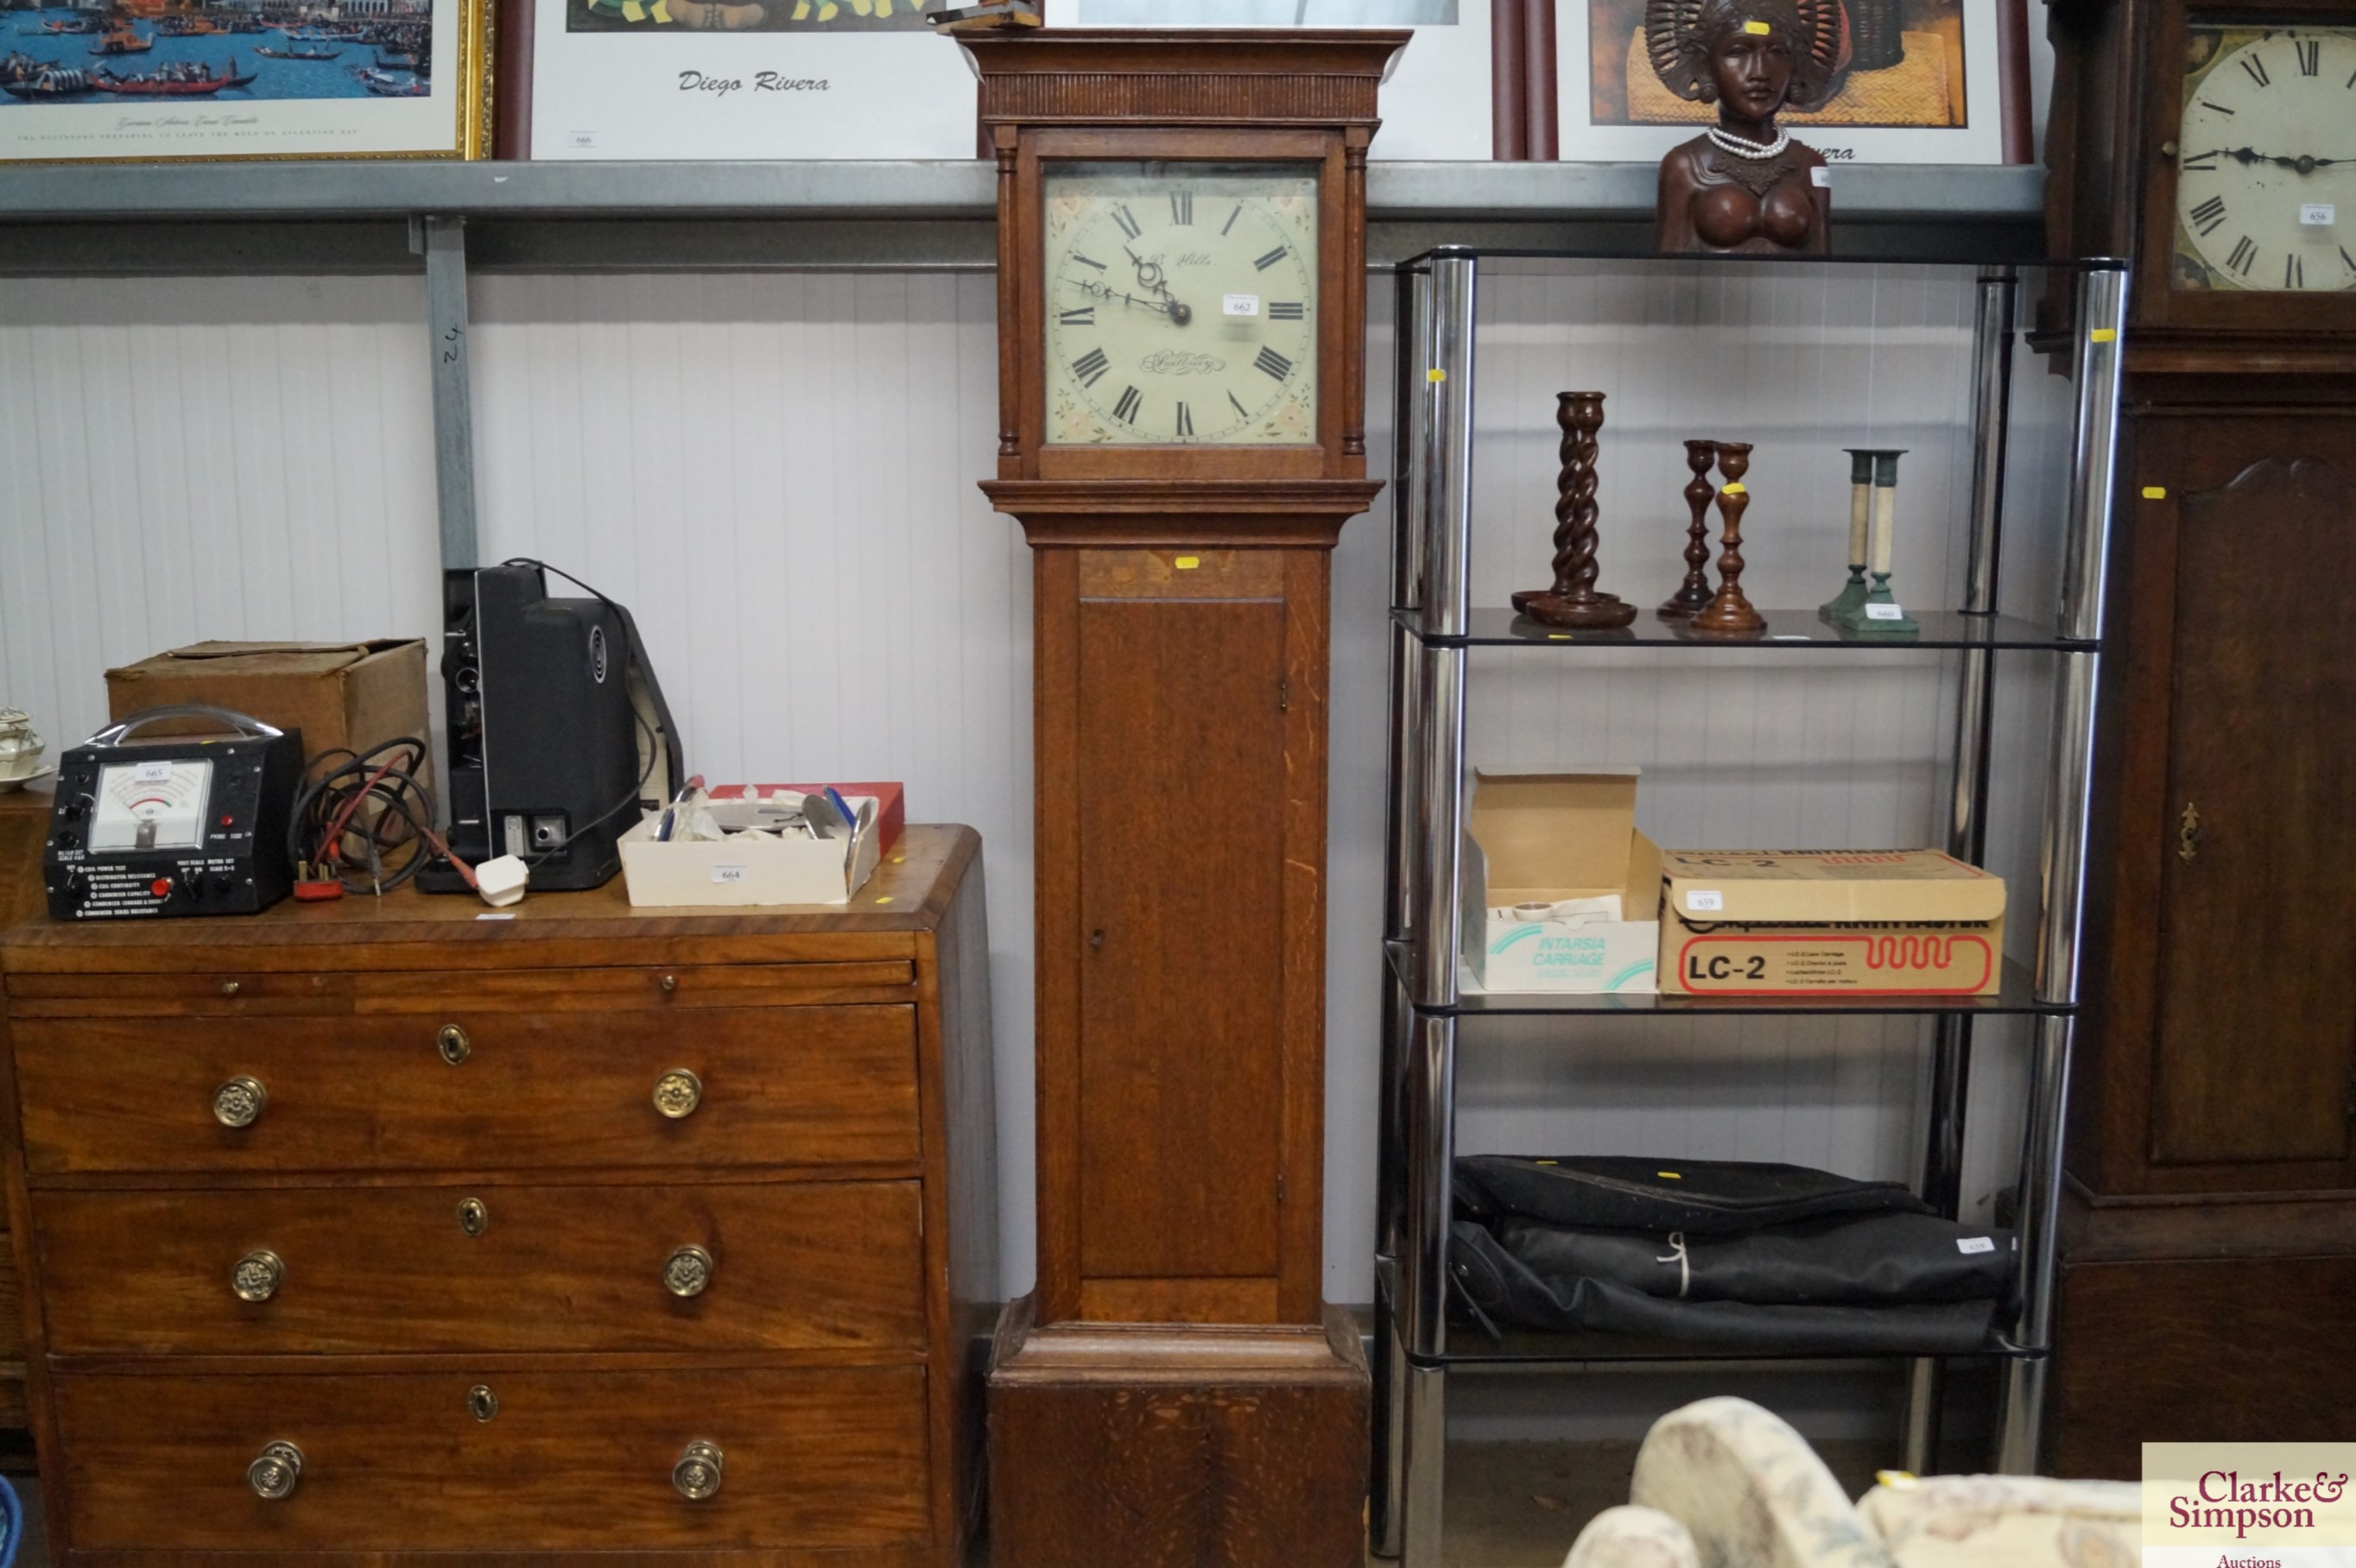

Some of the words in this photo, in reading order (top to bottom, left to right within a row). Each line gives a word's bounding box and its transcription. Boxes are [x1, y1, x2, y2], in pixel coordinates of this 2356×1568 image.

[678, 71, 743, 97] Diego
[754, 71, 830, 92] Rivera
[1169, 190, 1194, 226] XII
[2309, 212, 2327, 221] 656
[1233, 302, 1251, 312] 662
[146, 768, 162, 777] 665
[722, 870, 740, 879] 664
[1698, 898, 1715, 907] 659
[1539, 938, 1605, 951] INTARSIA
[1533, 952, 1605, 965] CARRIAGE
[1688, 955, 1766, 980] LC-2
